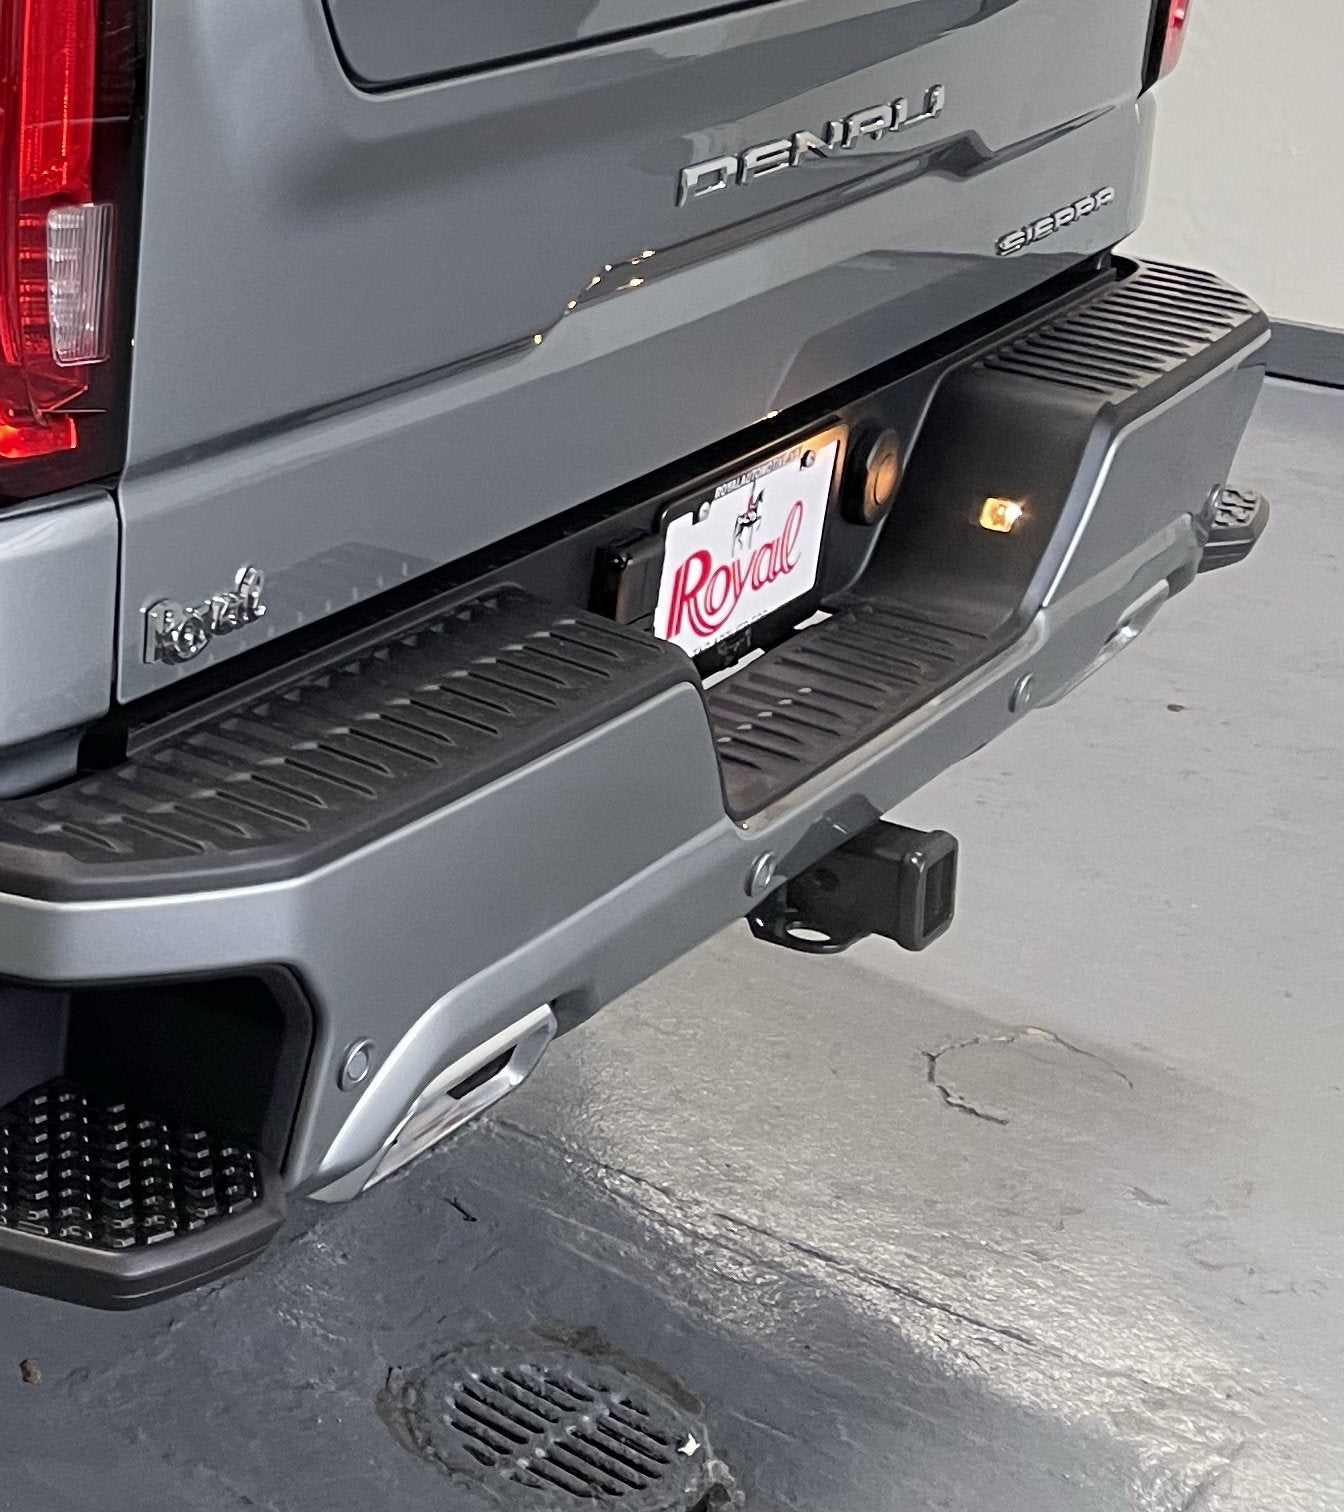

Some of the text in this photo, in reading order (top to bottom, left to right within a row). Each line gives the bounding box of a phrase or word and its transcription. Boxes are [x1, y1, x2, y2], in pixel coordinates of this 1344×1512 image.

[675, 83, 945, 207] DENALI
[994, 186, 1115, 256] SIERRA
[665, 500, 802, 641] Royal
